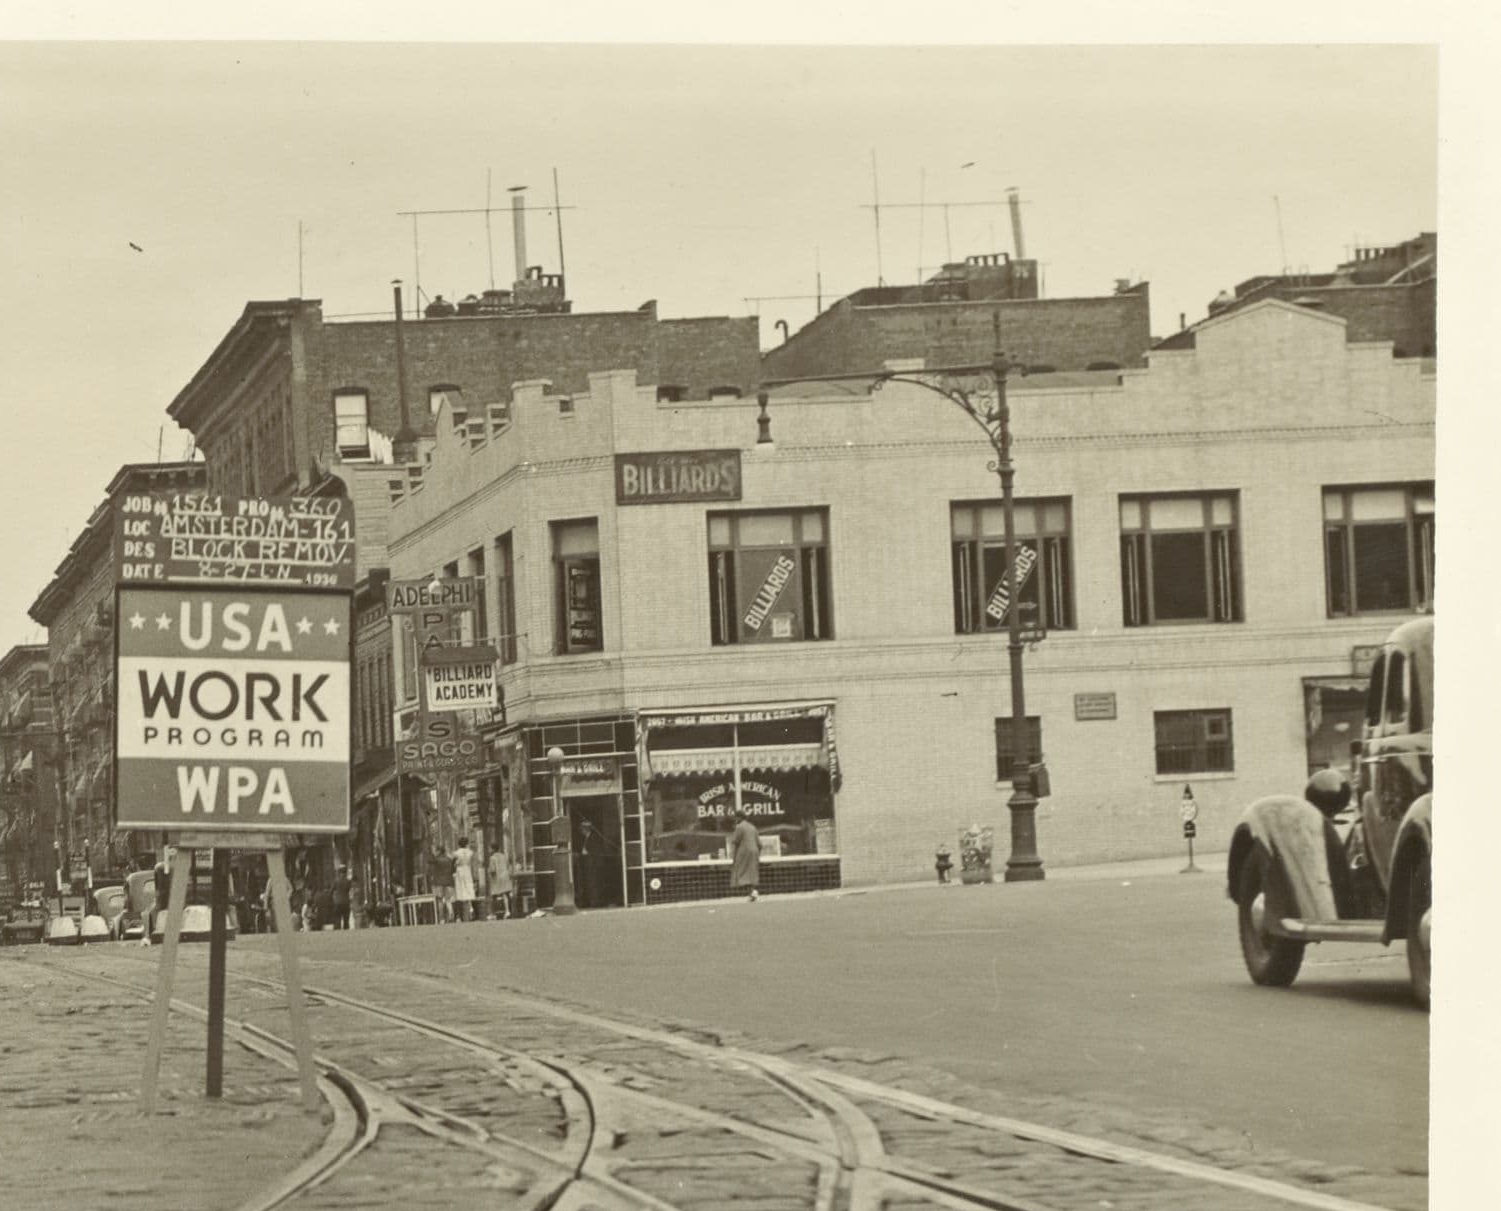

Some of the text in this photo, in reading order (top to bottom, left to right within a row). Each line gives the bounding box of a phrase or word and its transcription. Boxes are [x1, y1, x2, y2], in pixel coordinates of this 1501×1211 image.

[622, 460, 738, 496] BILLIARDS
[122, 496, 151, 513] JOB
[171, 494, 222, 514] 1561
[238, 500, 268, 517] PRO
[289, 498, 341, 518] 360
[124, 520, 150, 536] LOC
[124, 541, 155, 558] DES
[171, 537, 246, 560] BLOCK
[122, 562, 164, 579] DATE
[393, 582, 471, 609] ADELPHI
[744, 556, 794, 630] BILLIARDS
[180, 601, 293, 652] USA
[433, 664, 493, 683] BILLIARD
[138, 669, 331, 723] WORK
[435, 683, 494, 701] ACADEMY
[699, 713, 740, 726] AMERICAN
[743, 711, 764, 722] BAR
[143, 727, 324, 749] PROGRAM
[403, 741, 476, 760] SAGO
[176, 765, 296, 816] WPA
[699, 784, 725, 804] IRISH
[697, 803, 726, 818] BAR
[743, 802, 786, 816] GRILL
